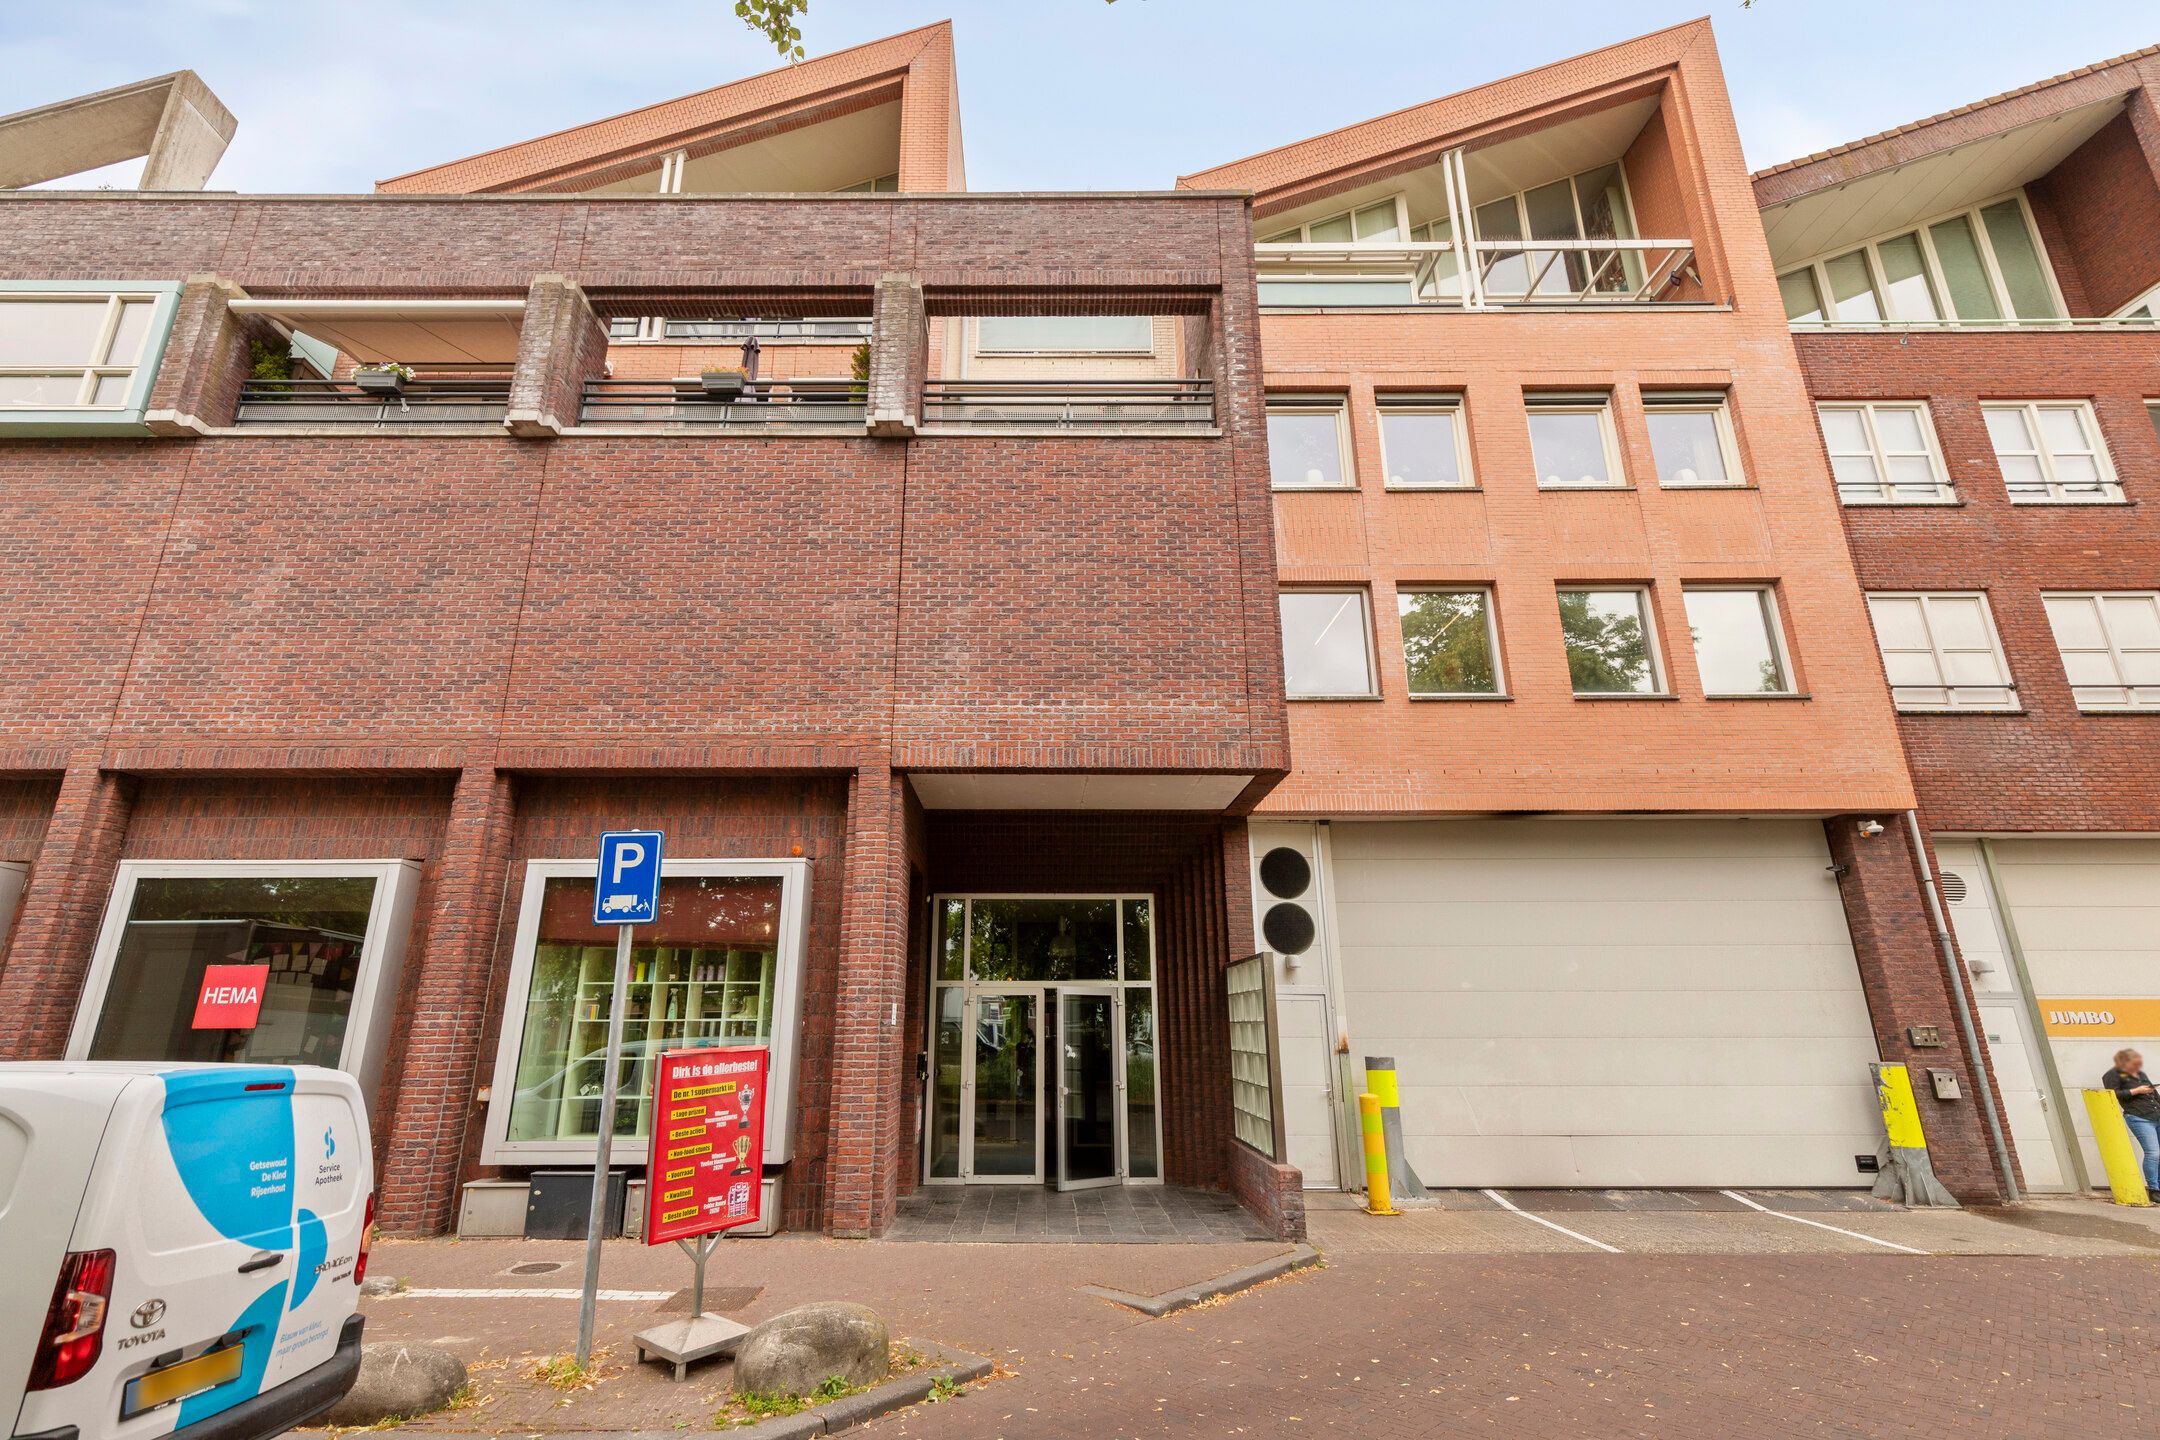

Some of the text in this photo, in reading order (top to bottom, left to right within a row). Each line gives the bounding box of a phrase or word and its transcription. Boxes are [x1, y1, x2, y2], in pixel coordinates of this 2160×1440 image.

[612, 842, 645, 884] P
[203, 986, 258, 1005] HEMA
[2048, 1010, 2116, 1026] JUMBO
[672, 1059, 758, 1079] Dirk is de allerbeste!
[673, 1091, 682, 1099] De
[695, 1085, 727, 1096] supermarkt
[676, 1110, 688, 1118] Lage
[675, 1127, 705, 1138] Beste acties
[249, 1157, 287, 1171] Getsewoud
[318, 1163, 341, 1174] Service
[261, 1172, 271, 1182] De
[315, 1173, 343, 1186] Apotheek
[671, 1168, 694, 1179] Voorraad
[251, 1184, 286, 1198] Rijsenhout
[667, 1212, 682, 1221] Beste
[117, 1328, 166, 1350] TOYOTA
